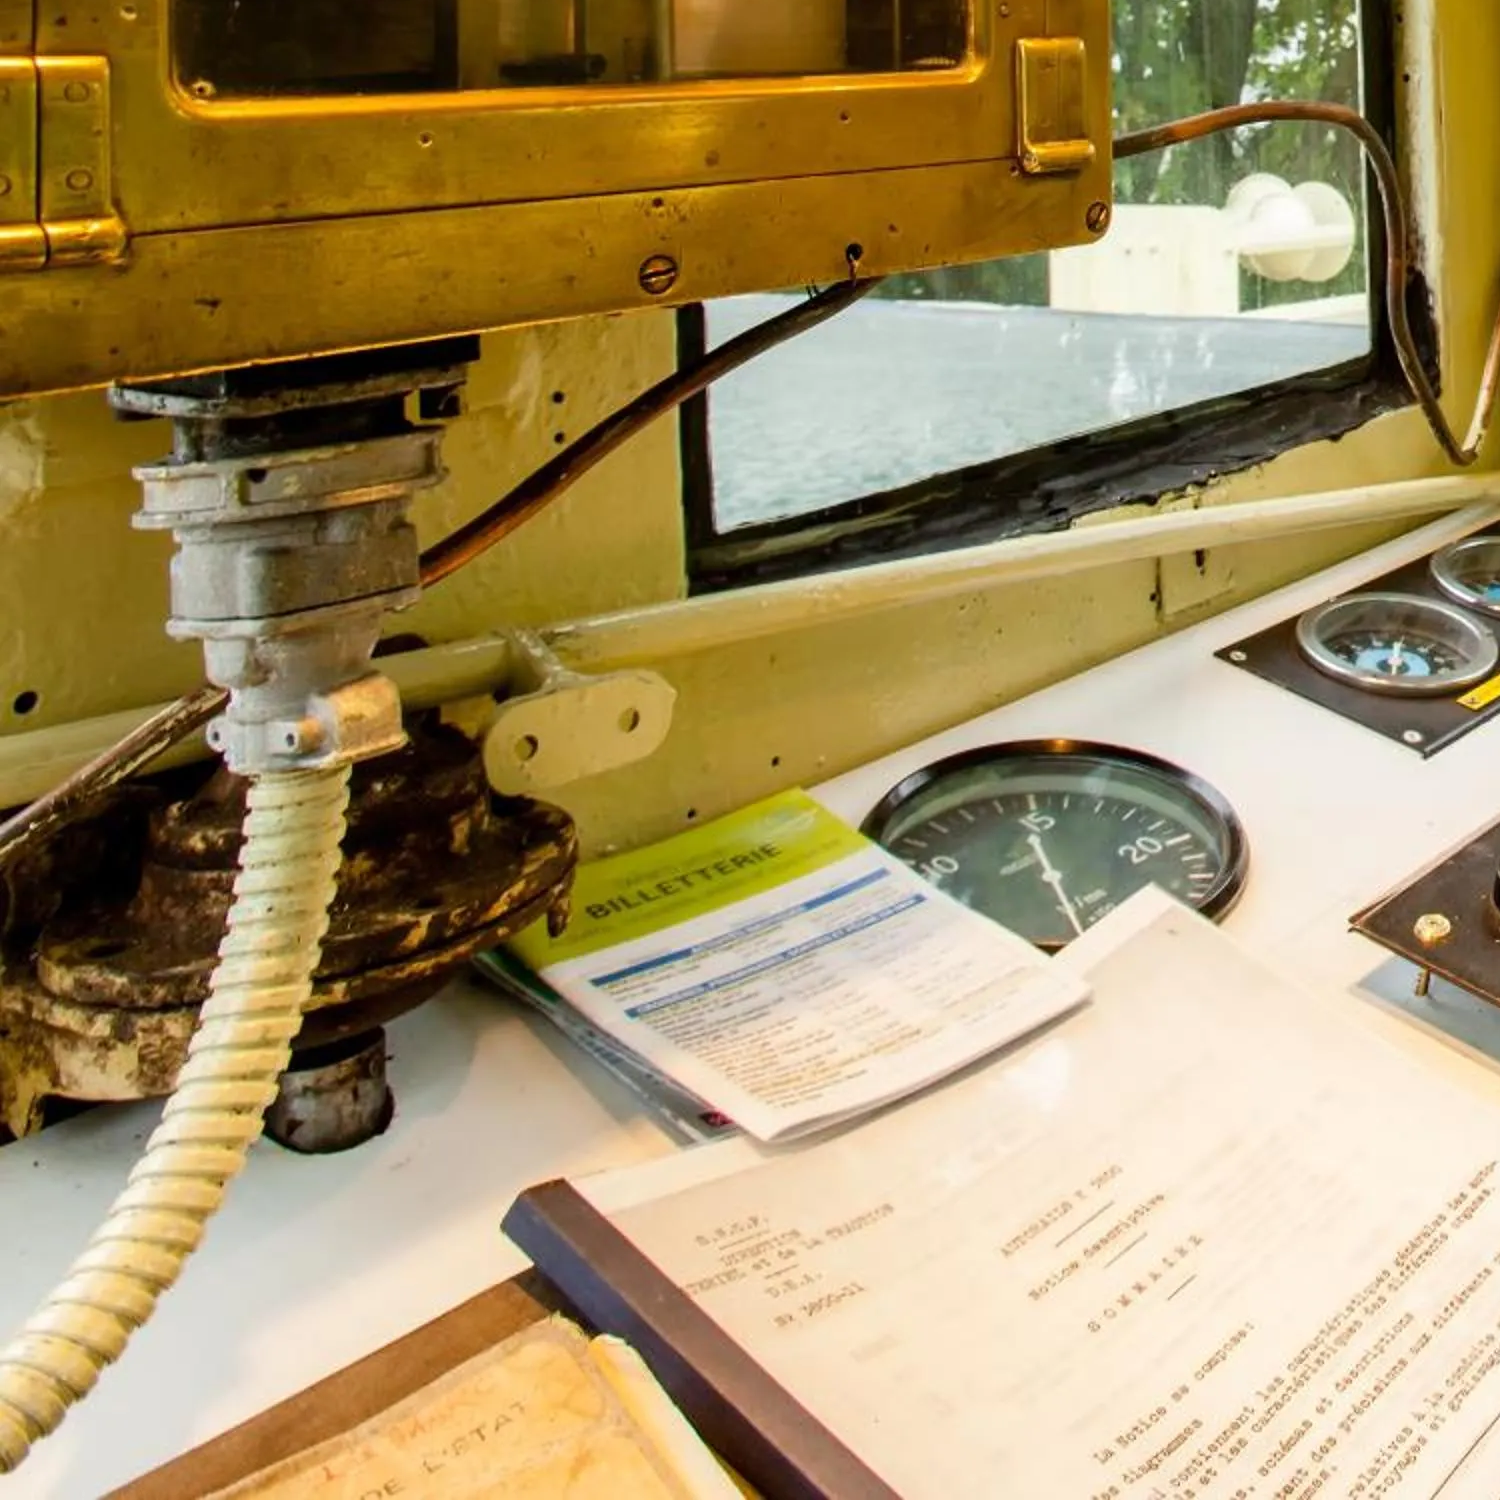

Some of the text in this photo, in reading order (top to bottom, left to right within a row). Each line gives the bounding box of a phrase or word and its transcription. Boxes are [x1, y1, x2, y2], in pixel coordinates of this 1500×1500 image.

[1019, 811, 1057, 833] 15
[1118, 836, 1163, 865] 20
[585, 843, 782, 920] BILLETTERIE
[1028, 1193, 1165, 1302] Notice descriptive
[1116, 1406, 1167, 1447] Notice
[1171, 1385, 1190, 1402] se
[1257, 1311, 1415, 1477] schémas et descriptions
[1311, 1436, 1338, 1463] des
[1338, 1357, 1408, 1433] précisions
[1429, 1414, 1446, 1431] et
[1122, 1418, 1203, 1485] diagrammes
[1170, 1405, 1256, 1489] contiennent
[1200, 1467, 1218, 1486] et
[1219, 1437, 1249, 1464] les
